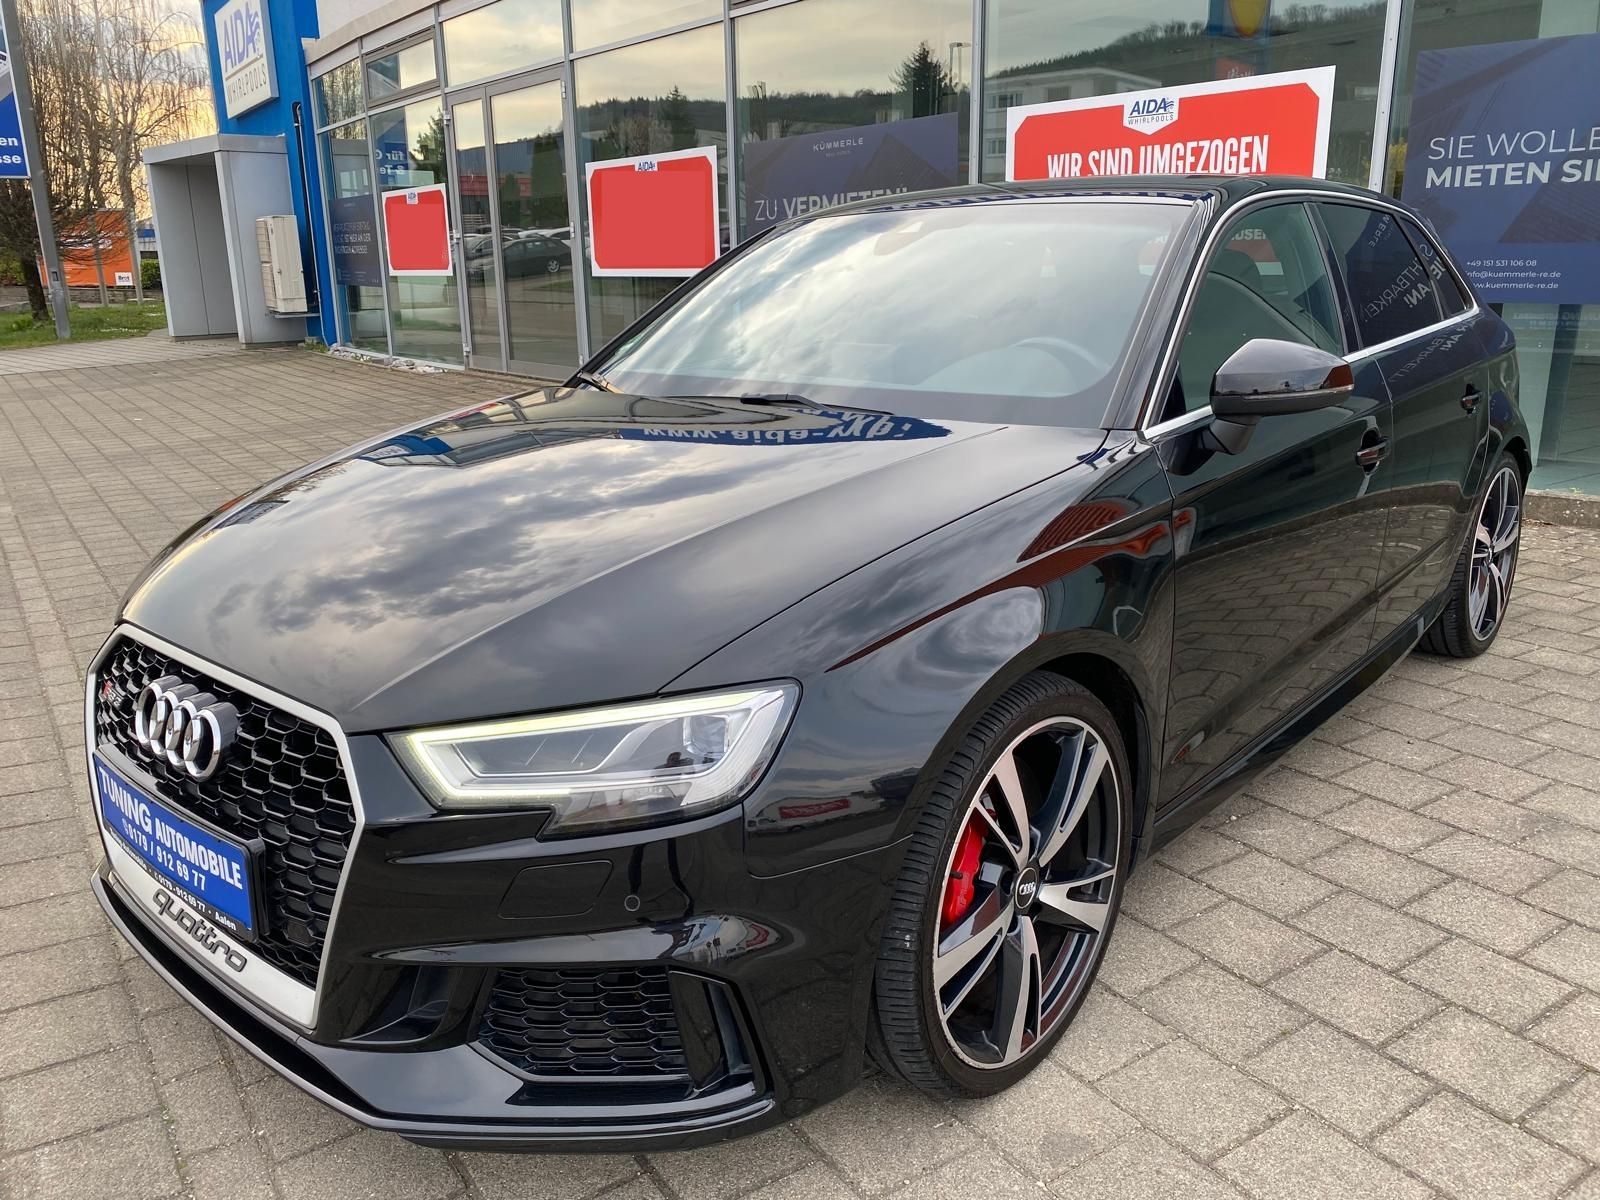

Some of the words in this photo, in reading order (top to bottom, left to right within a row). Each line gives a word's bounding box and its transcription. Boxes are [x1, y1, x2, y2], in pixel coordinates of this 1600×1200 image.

[224, 1, 258, 73] AIDA
[227, 63, 267, 105] WHIRLPOOLS
[1128, 114, 1174, 124] WHIRLPOOLS
[1130, 98, 1169, 115] AIDA
[813, 137, 864, 152] KÜMMERLE
[1047, 151, 1083, 178] WIR
[1088, 147, 1133, 176] SIND
[1139, 134, 1269, 175] UMGEZOGEN
[1428, 135, 1476, 160] SIE
[0, 154, 21, 164] se
[1426, 160, 1551, 189] MIETEN
[1560, 158, 1600, 183] SI
[754, 200, 778, 221] ZU
[1466, 259, 1481, 267] +49
[1483, 259, 1494, 267] 151
[1495, 259, 1508, 267] 531
[1510, 259, 1524, 267] 106
[1525, 259, 1537, 267] 08
[98, 766, 153, 836] TUNING
[155, 817, 244, 891] AUTOMOBILE
[128, 823, 148, 851] 0179
[156, 847, 175, 872] 912
[176, 859, 190, 882] 69
[192, 869, 206, 891] 77
[152, 887, 248, 973] quattro
[215, 911, 237, 931] Aalen
